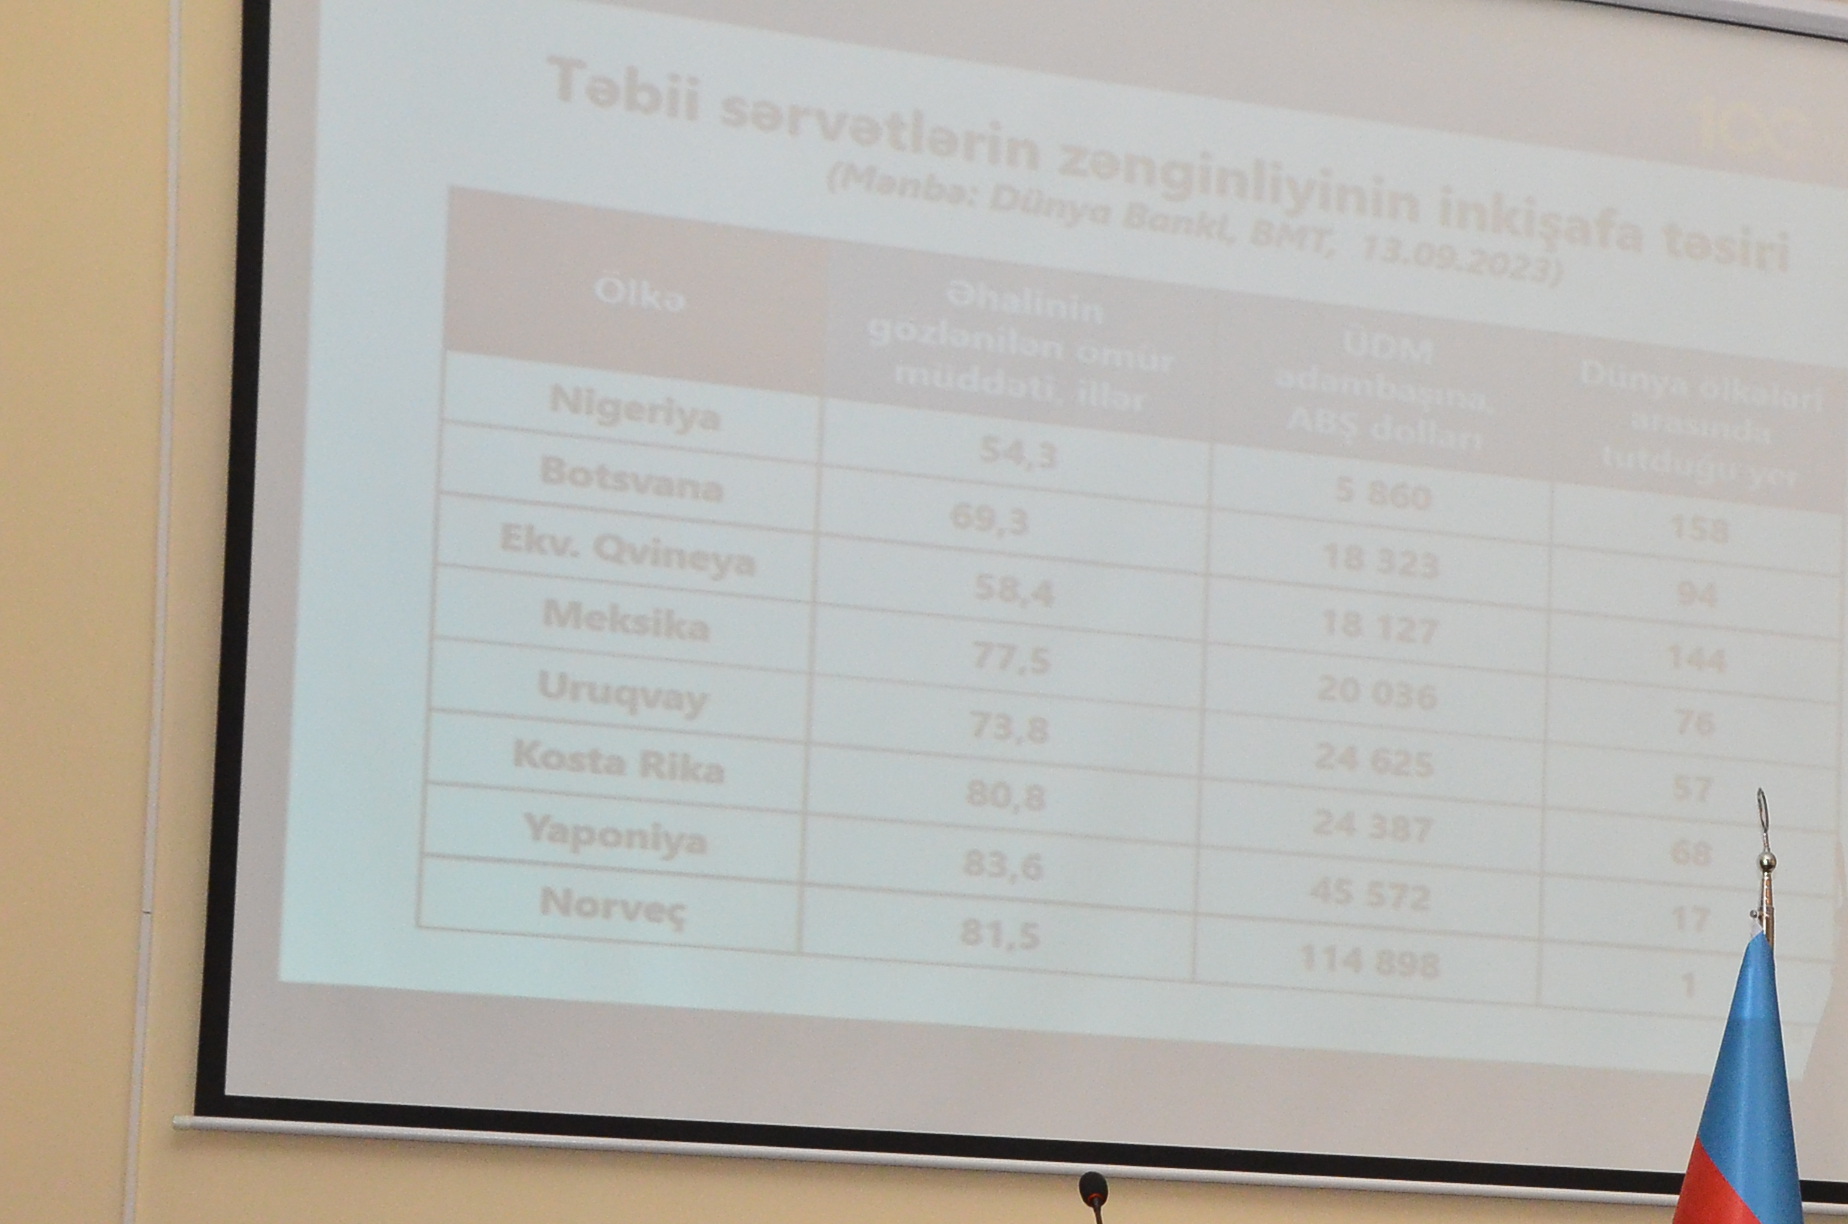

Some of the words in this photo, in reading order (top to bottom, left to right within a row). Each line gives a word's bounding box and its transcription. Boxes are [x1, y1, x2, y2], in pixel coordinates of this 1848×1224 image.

[546, 54, 701, 122] Təbii
[719, 92, 1041, 171] sərvətlərin
[1058, 141, 1421, 224] zənginliyinin
[1438, 185, 1645, 254] inkişafa
[1661, 220, 1792, 273] təsiri
[1363, 233, 1565, 290] 13.09.2023)
[592, 269, 687, 314] Ölkə
[549, 383, 722, 435] Nigeriya
[979, 434, 1059, 475] 54,3
[539, 455, 726, 504] Botsvana
[949, 502, 1030, 539] 69,3
[500, 522, 580, 560] Ekv.
[592, 533, 758, 581] Qvineya
[973, 572, 1056, 608] 58,4
[541, 599, 711, 644] Meksika
[971, 640, 1052, 677] 77,5
[537, 670, 710, 720] Uruqvay
[968, 710, 1050, 747] 73,8
[512, 739, 626, 780] Kosta
[639, 750, 727, 786] Rika
[964, 779, 1047, 815] 80,8
[523, 812, 710, 861] Yaponiya
[962, 848, 1044, 884] 83,6
[539, 886, 688, 931] Norveç
[959, 918, 1041, 953] 81,5
